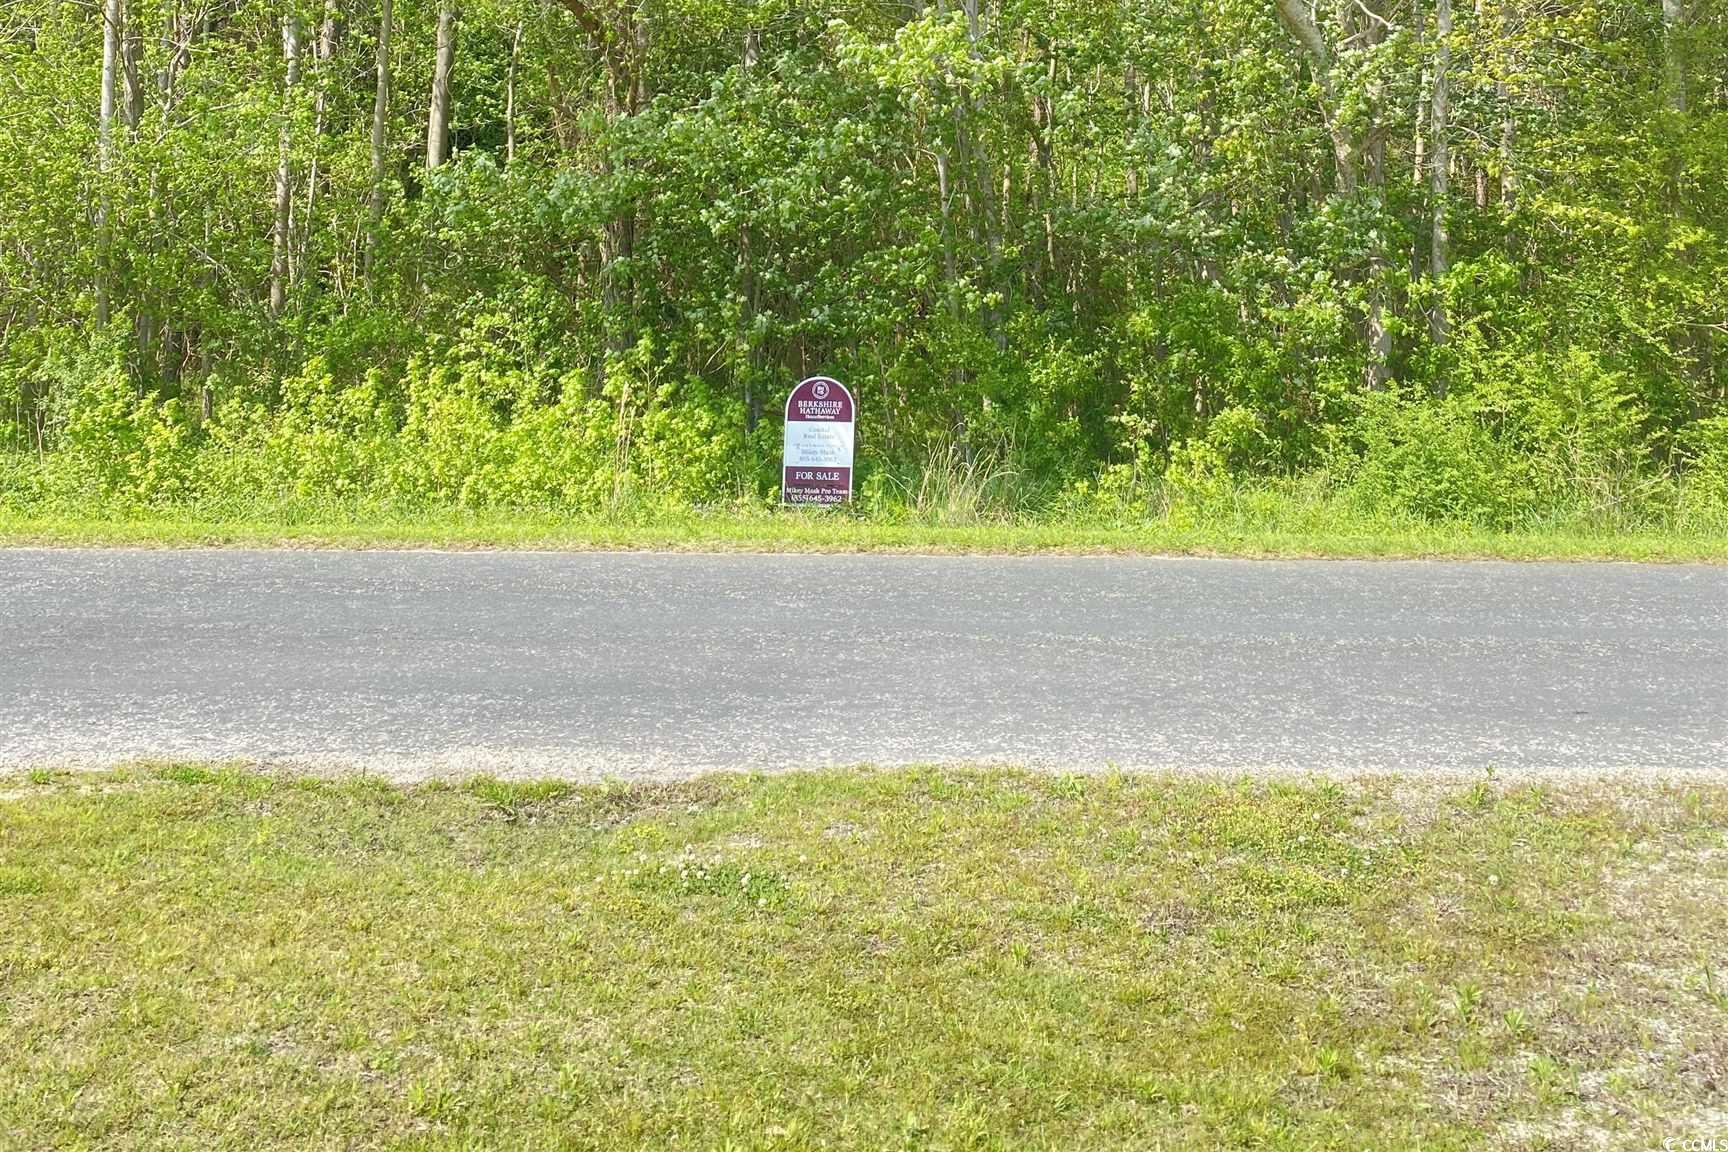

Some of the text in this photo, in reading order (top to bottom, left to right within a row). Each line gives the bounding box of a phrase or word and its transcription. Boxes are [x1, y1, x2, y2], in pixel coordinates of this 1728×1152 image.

[798, 400, 843, 408] BERKSHIRE
[795, 471, 840, 481] FOR SALE
